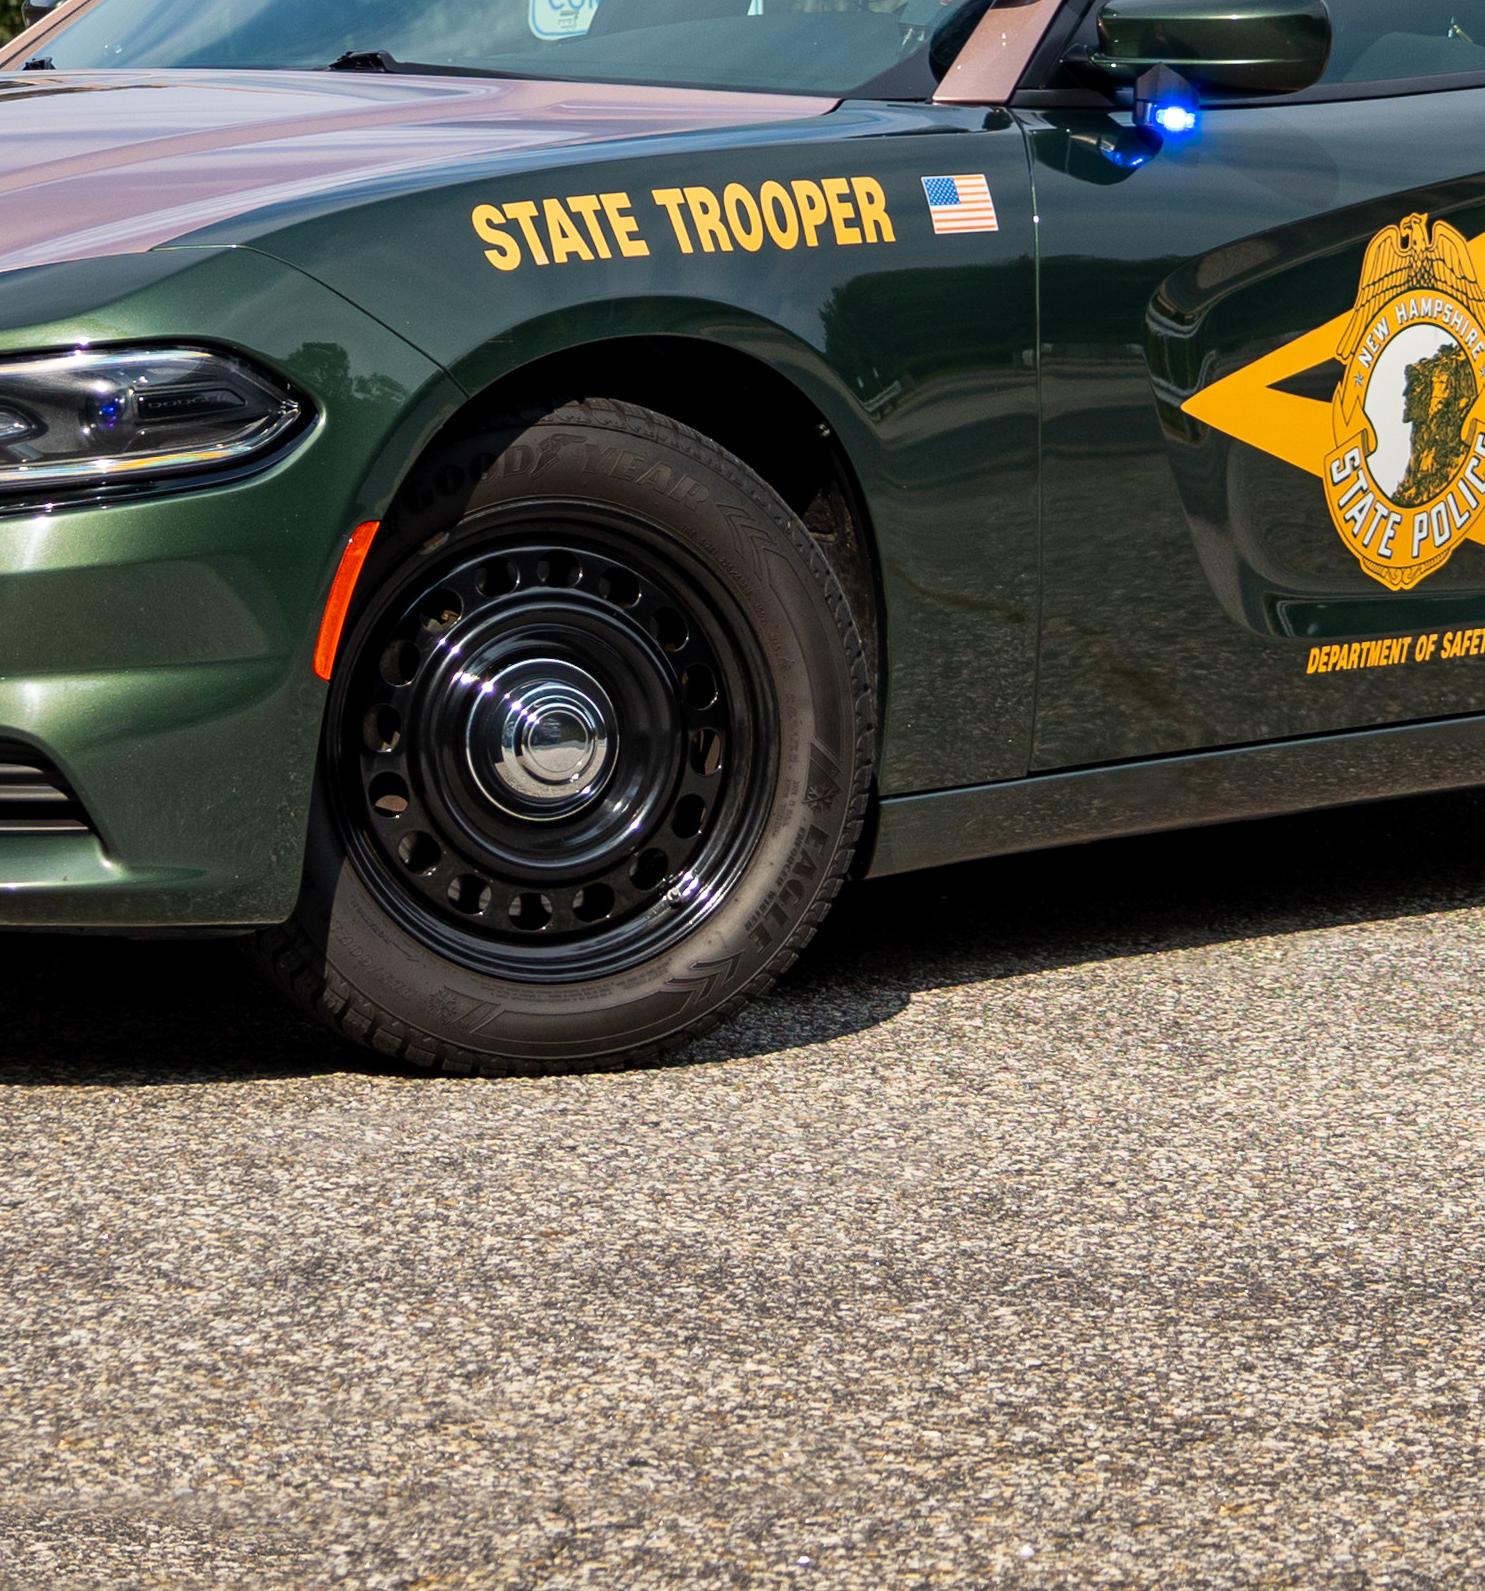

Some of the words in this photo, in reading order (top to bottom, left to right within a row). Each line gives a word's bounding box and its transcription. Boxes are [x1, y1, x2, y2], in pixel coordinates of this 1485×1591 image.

[470, 191, 651, 272] STATE
[651, 175, 897, 255] TROOPER
[1357, 314, 1392, 370] NEW
[1394, 296, 1485, 362] HAMPSHIRE
[580, 442, 710, 513] YEAR
[1330, 446, 1403, 559] STATE
[1305, 636, 1412, 675] DEPARTMENT
[1414, 633, 1439, 662] OF
[748, 823, 833, 957] EAGLE
